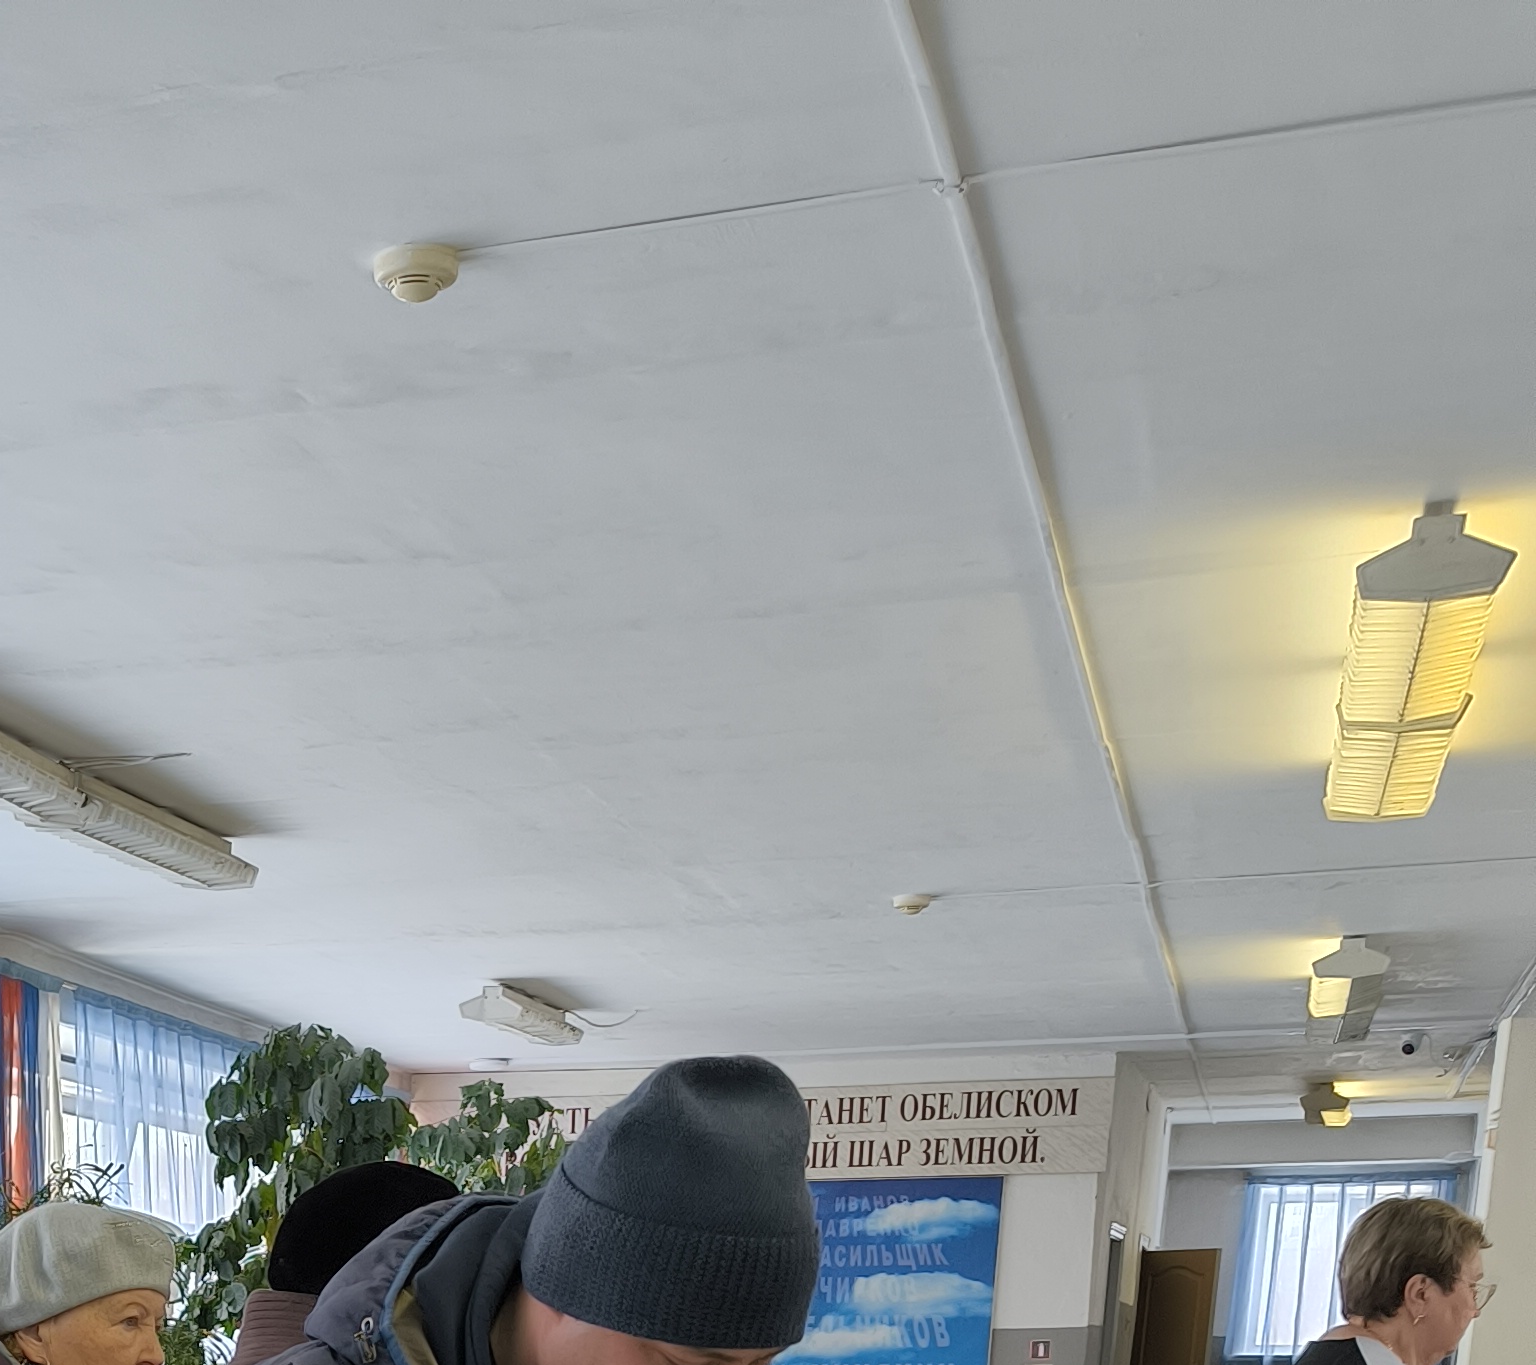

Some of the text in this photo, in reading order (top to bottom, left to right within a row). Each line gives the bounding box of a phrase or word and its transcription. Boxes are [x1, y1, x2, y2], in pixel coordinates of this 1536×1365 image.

[900, 1087, 1080, 1122] ОБЕЛИСКОМ
[847, 1139, 912, 1168] ШАР
[918, 1128, 1046, 1167] ЗЕМНОЙ.
